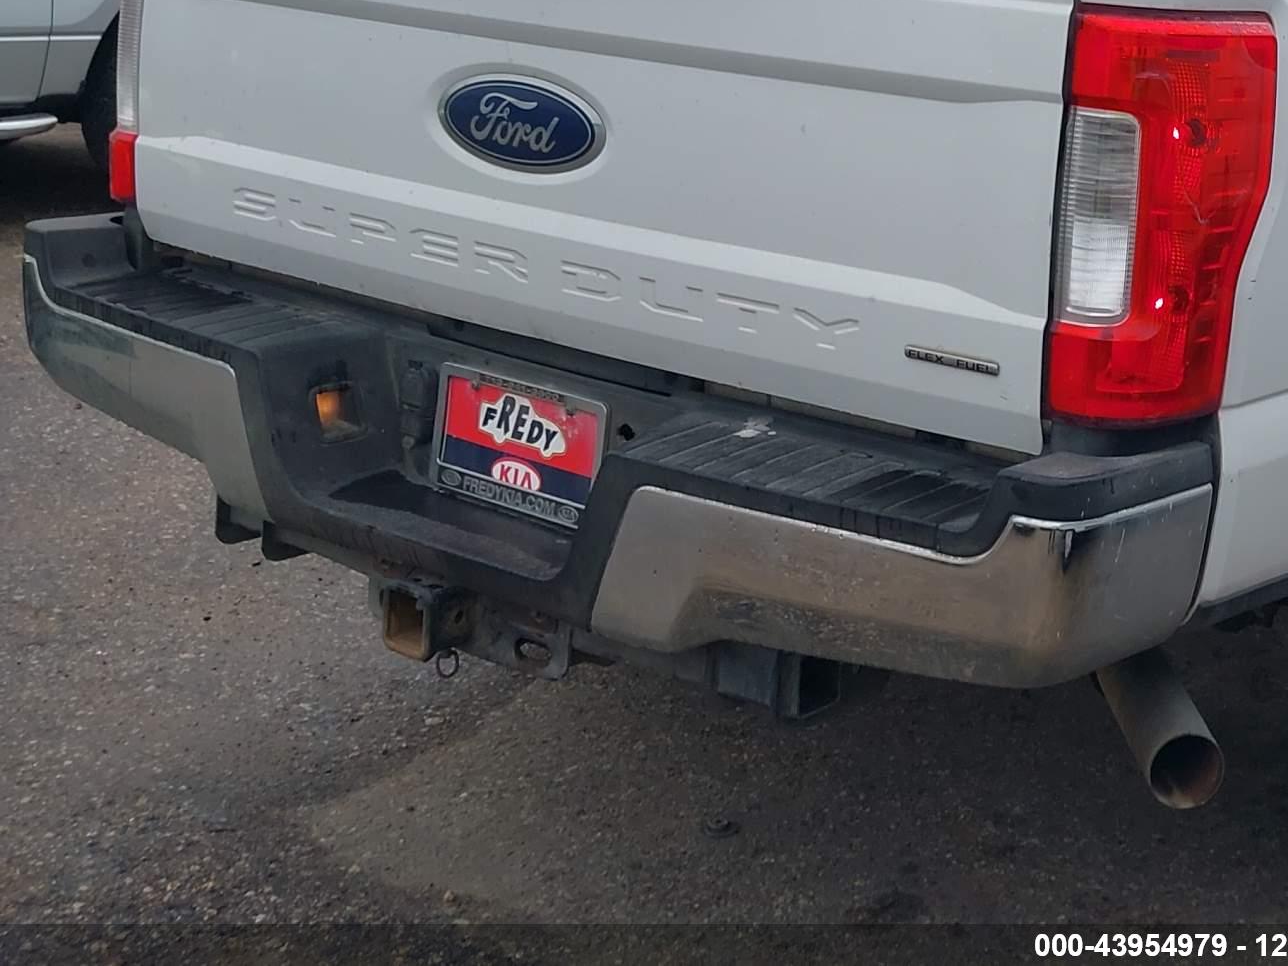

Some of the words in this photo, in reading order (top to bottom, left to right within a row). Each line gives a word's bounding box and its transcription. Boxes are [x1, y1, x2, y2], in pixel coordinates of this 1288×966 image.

[470, 92, 559, 155] Ford
[231, 185, 529, 284] SUPER
[560, 258, 862, 353] DUTY
[481, 394, 559, 452] FREDY
[462, 476, 558, 517] FREDYKIA.COM
[498, 464, 532, 489] KIA
